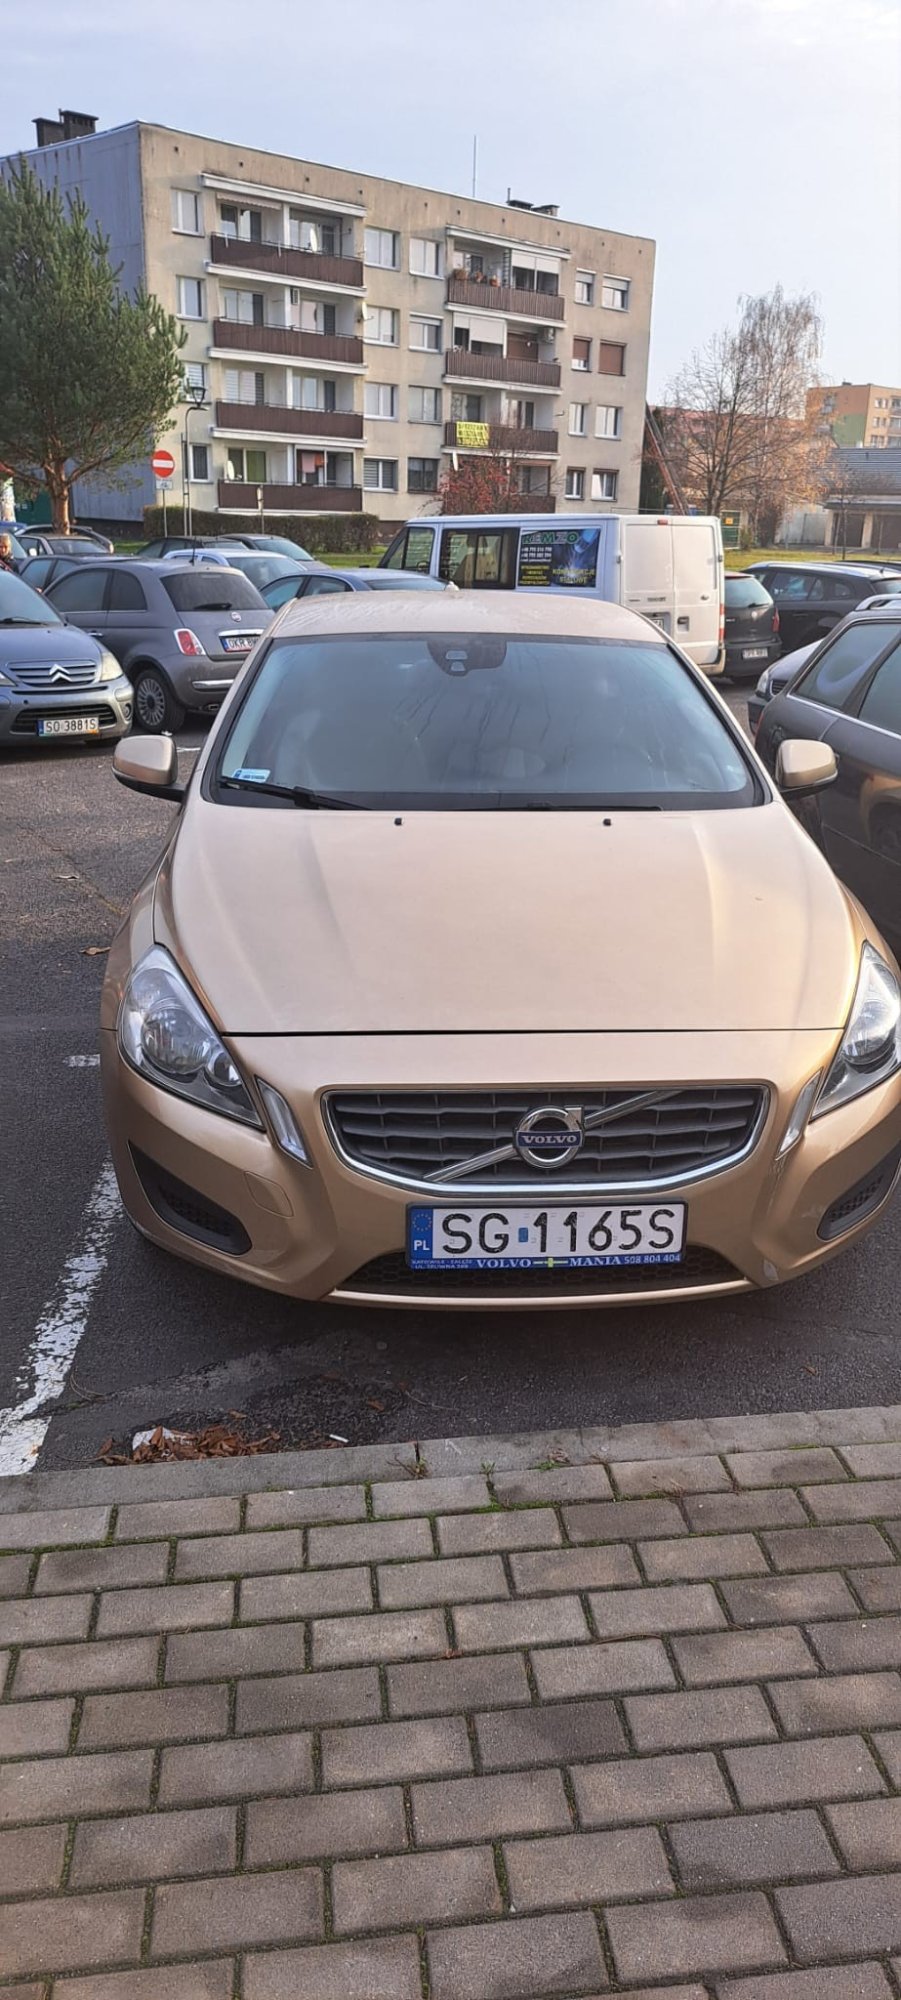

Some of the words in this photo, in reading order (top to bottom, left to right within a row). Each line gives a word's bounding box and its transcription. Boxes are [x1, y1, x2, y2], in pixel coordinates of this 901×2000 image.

[522, 531, 580, 545] REMZO
[521, 1135, 577, 1144] VOLVO
[413, 1239, 430, 1251] PL
[441, 1212, 510, 1255] SG
[533, 1208, 675, 1253] 1165S
[476, 1258, 532, 1269] VOLVO
[569, 1256, 621, 1267] MANIA
[624, 1255, 641, 1265] 508
[643, 1254, 661, 1264] 804
[663, 1253, 681, 1263] 404
